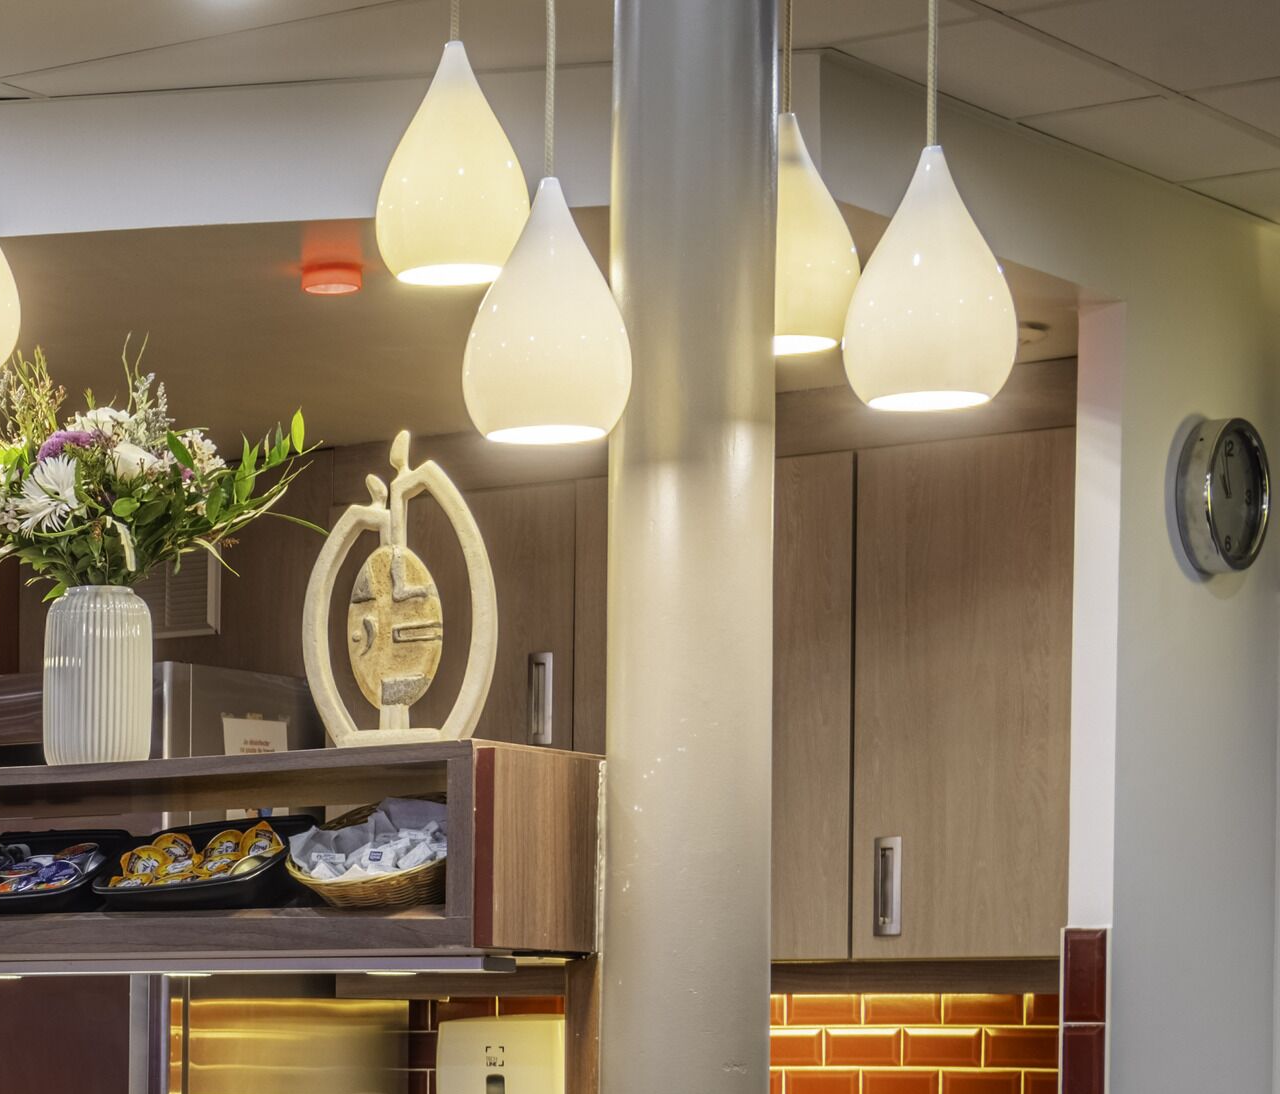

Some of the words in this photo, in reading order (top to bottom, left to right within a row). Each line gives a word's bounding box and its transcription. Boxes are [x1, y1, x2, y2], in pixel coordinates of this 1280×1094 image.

[1224, 439, 1235, 457] 12
[1245, 489, 1252, 506] 3
[1224, 535, 1232, 552] 6
